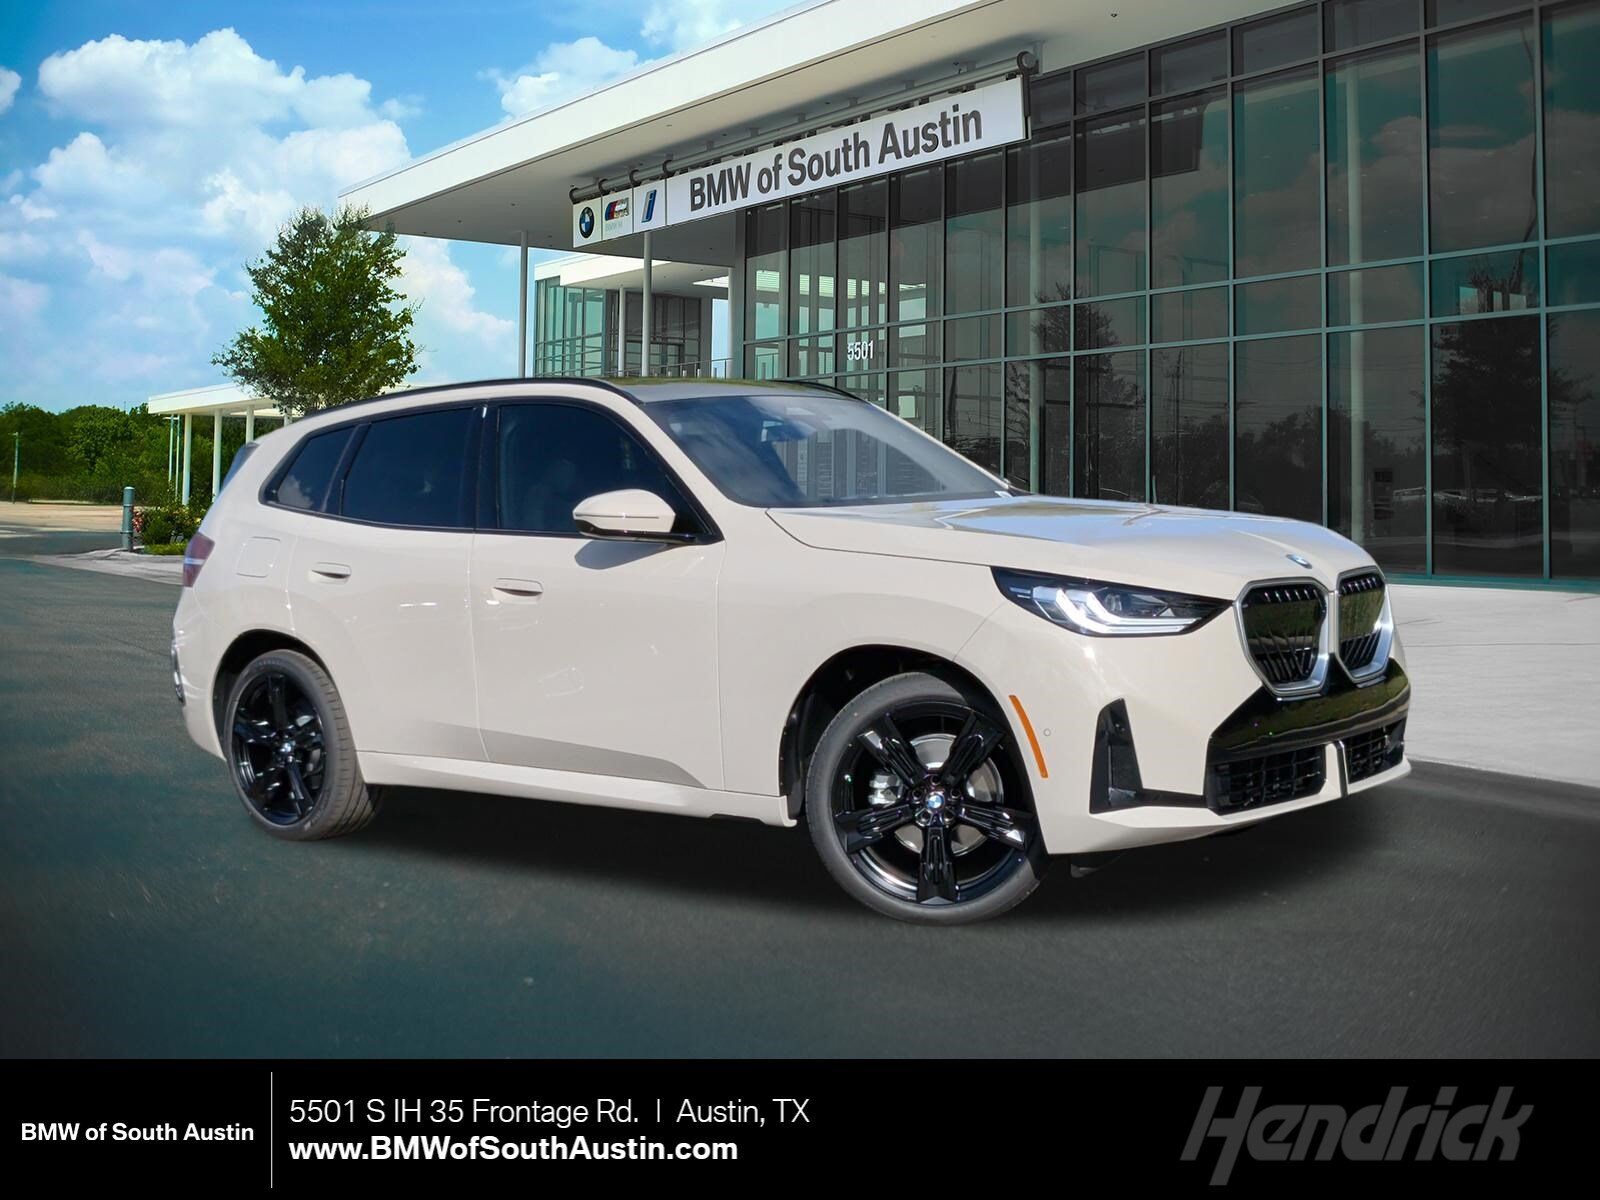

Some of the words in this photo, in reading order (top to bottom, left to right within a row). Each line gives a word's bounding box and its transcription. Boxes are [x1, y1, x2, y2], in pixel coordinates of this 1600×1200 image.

[690, 162, 751, 212] BMW
[757, 153, 783, 194] of
[787, 132, 870, 186] South
[878, 104, 982, 164] Austin
[847, 340, 874, 361] 5501
